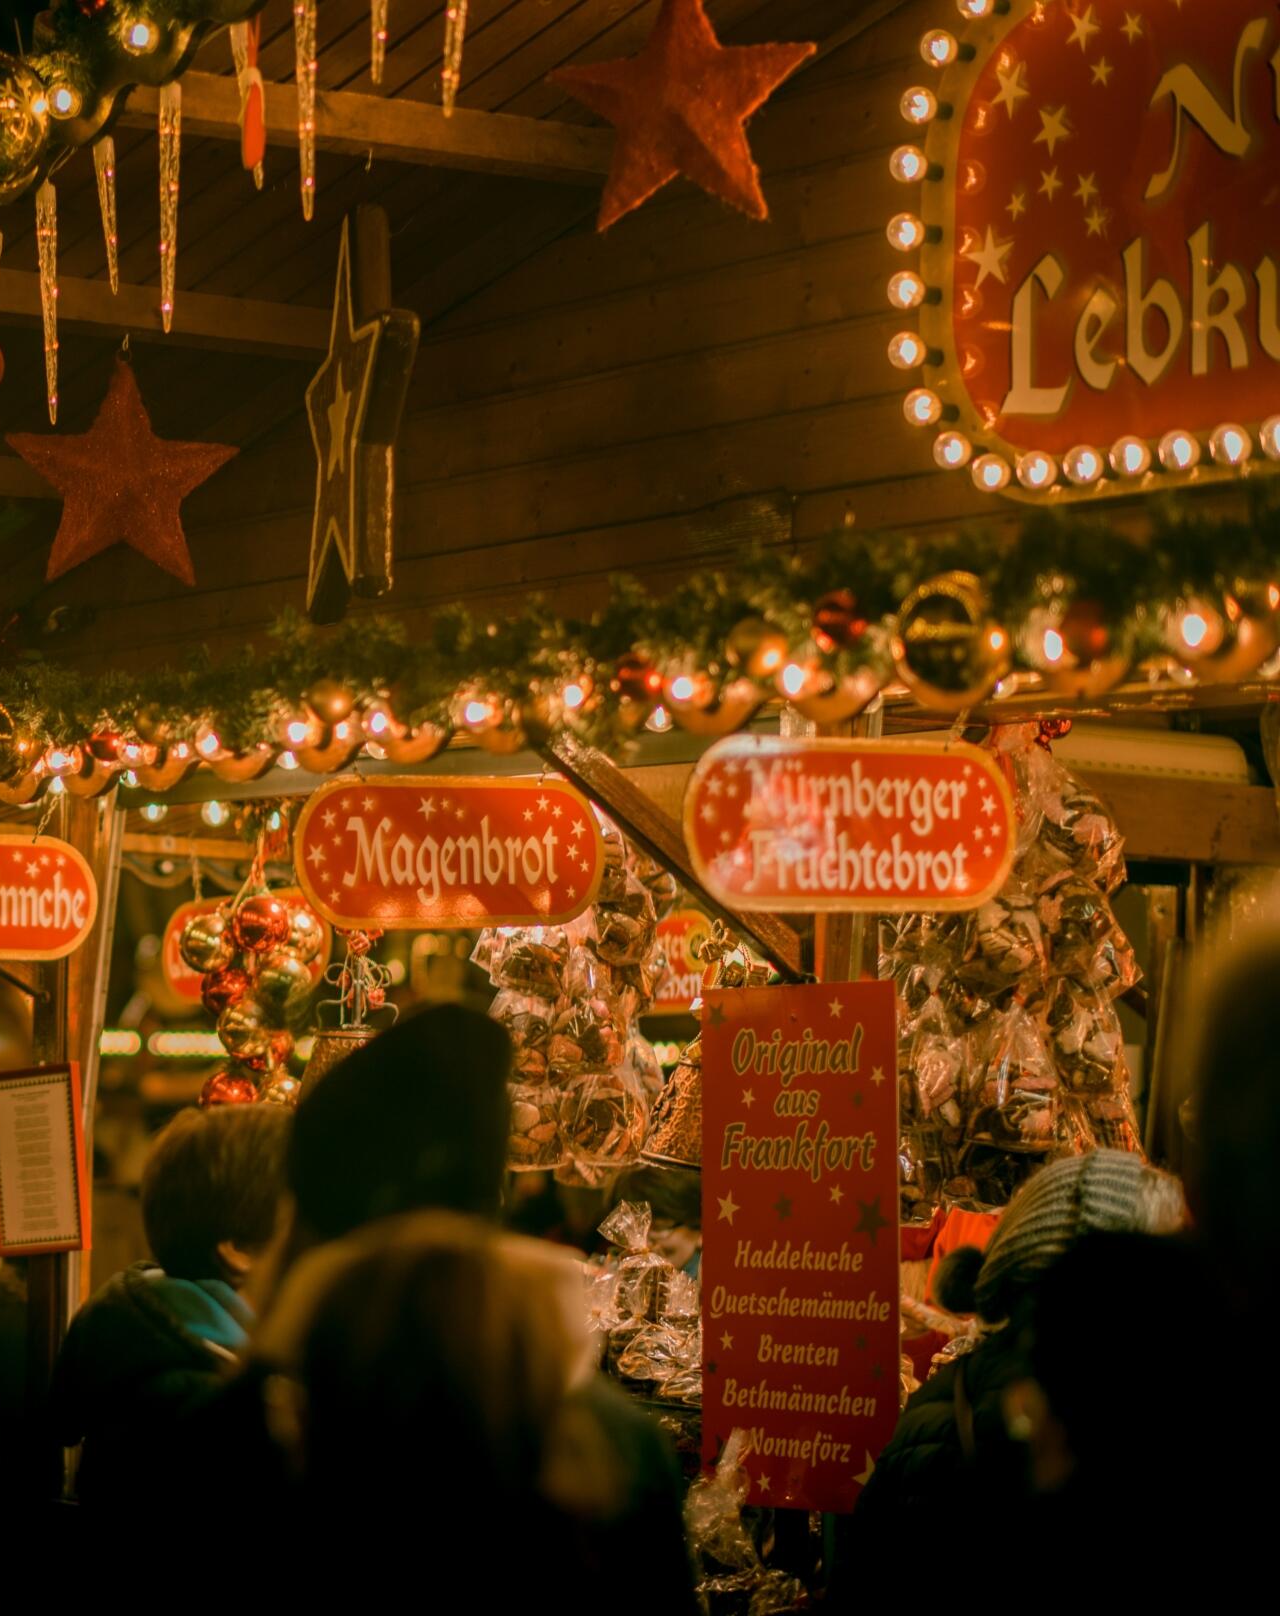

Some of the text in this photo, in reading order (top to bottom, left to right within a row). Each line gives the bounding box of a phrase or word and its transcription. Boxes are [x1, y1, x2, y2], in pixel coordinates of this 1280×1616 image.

[1144, 17, 1280, 199] N
[742, 758, 967, 837] Nürnberger
[342, 814, 559, 906] Magenbrot
[732, 1022, 864, 1087] Original
[773, 1090, 821, 1117] aus
[721, 1120, 877, 1183] Frankfort
[734, 1240, 863, 1272] Haddekuche
[710, 1286, 891, 1322] Quetschemännche
[757, 1334, 839, 1366] Brenten
[722, 1378, 877, 1418] Bethmännchen
[747, 1426, 852, 1468] Nonneförz
